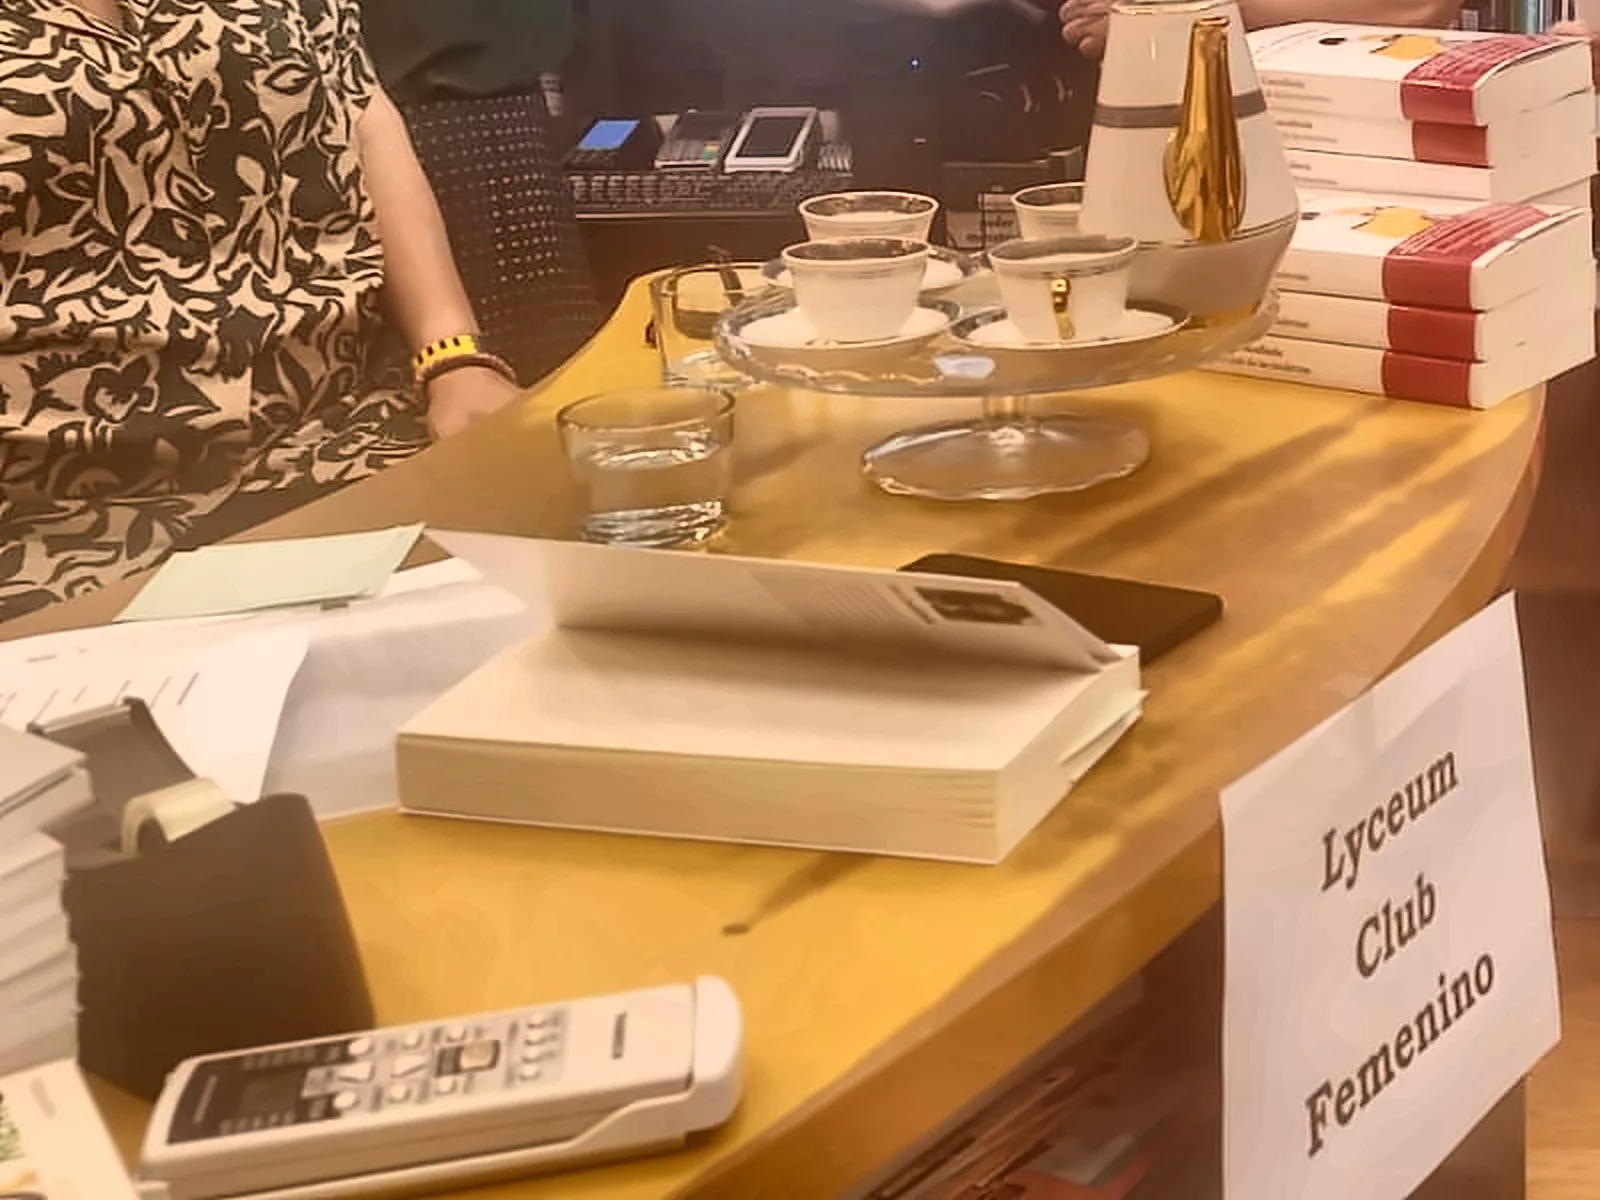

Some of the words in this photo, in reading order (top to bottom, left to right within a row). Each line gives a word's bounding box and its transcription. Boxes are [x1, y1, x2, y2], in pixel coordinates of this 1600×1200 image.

[1320, 750, 1459, 892] Lyceum
[1354, 872, 1438, 980] Club
[1303, 952, 1496, 1159] Femenino
